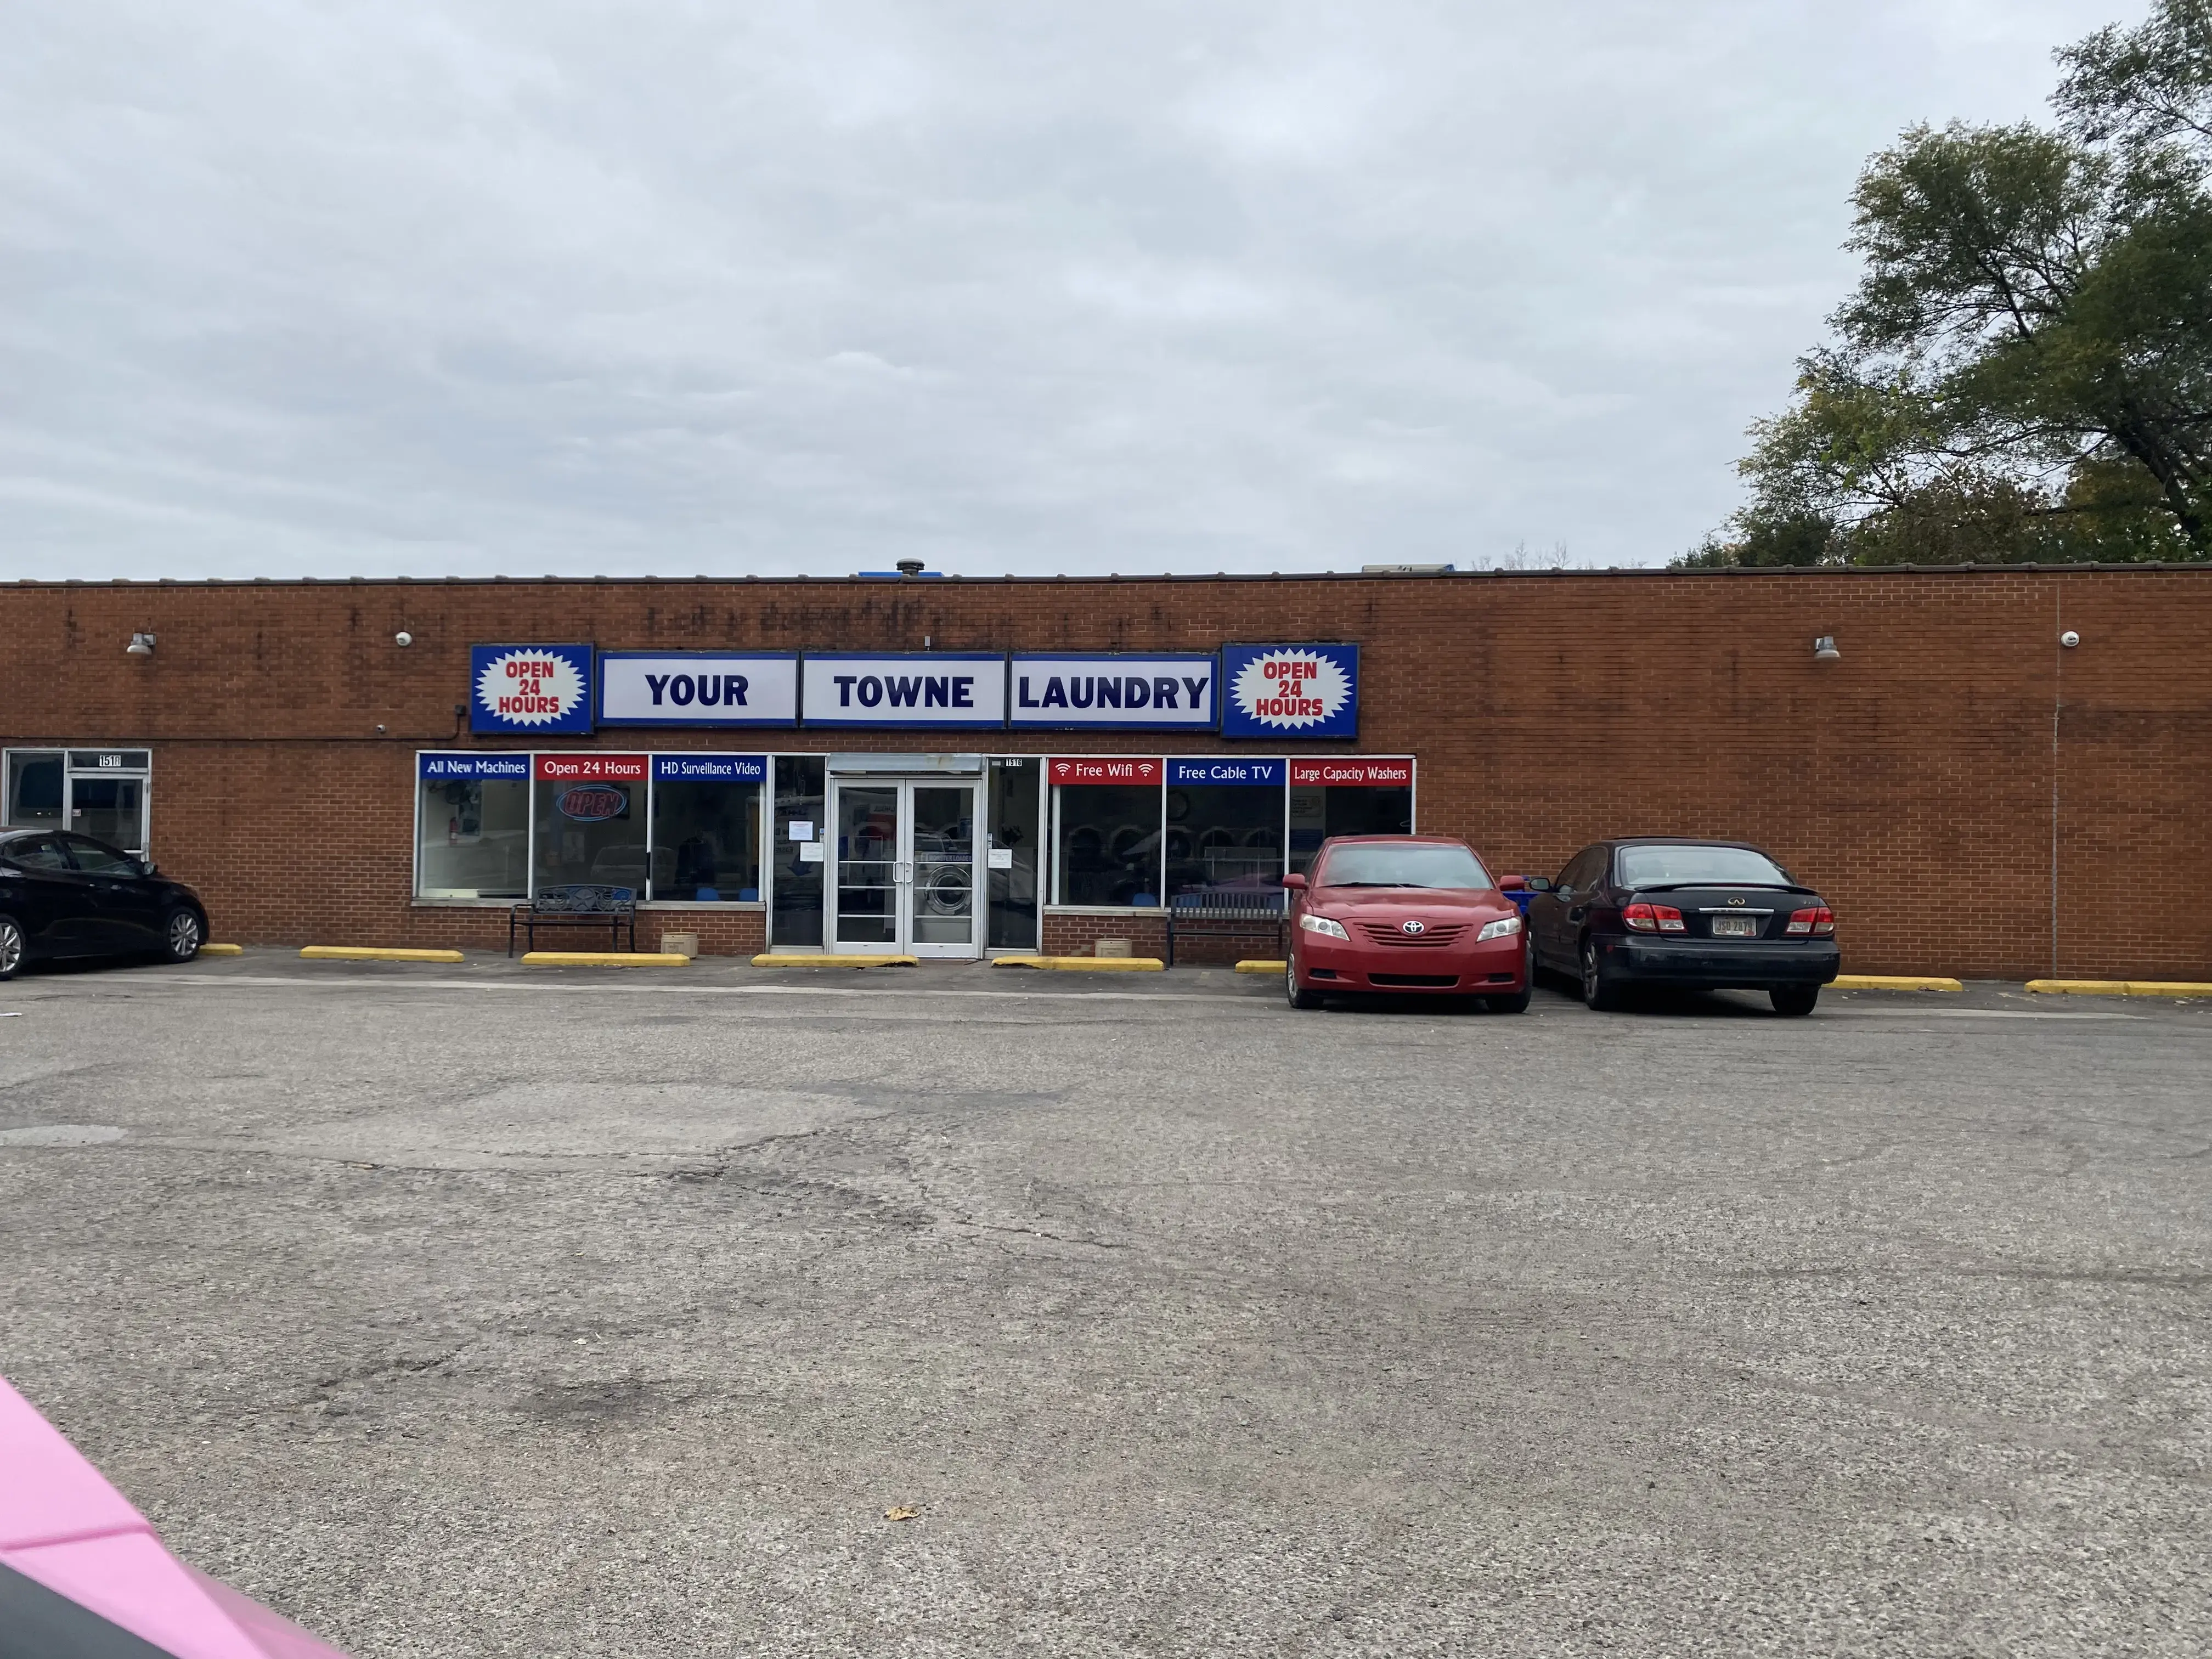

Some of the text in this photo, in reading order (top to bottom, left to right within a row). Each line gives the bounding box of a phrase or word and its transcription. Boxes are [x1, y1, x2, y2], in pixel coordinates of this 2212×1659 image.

[506, 661, 554, 678] OPEN
[1263, 662, 1317, 679] OPEN
[519, 679, 540, 696] 24
[645, 674, 1210, 709] YOUR TOWNE LAUNDRY
[1278, 680, 1302, 698] 24
[499, 696, 559, 713] HOURS
[1256, 698, 1323, 716] HOURS
[427, 760, 526, 774] All New Machines
[544, 761, 641, 776] Open 24 Hours
[661, 761, 760, 775] HD Surveillance Video
[1076, 763, 1133, 776] Free Wifi
[1179, 766, 1272, 779] Free Cable TV
[1295, 766, 1407, 782] Large Capacity Washers
[564, 792, 619, 816] OPEN
